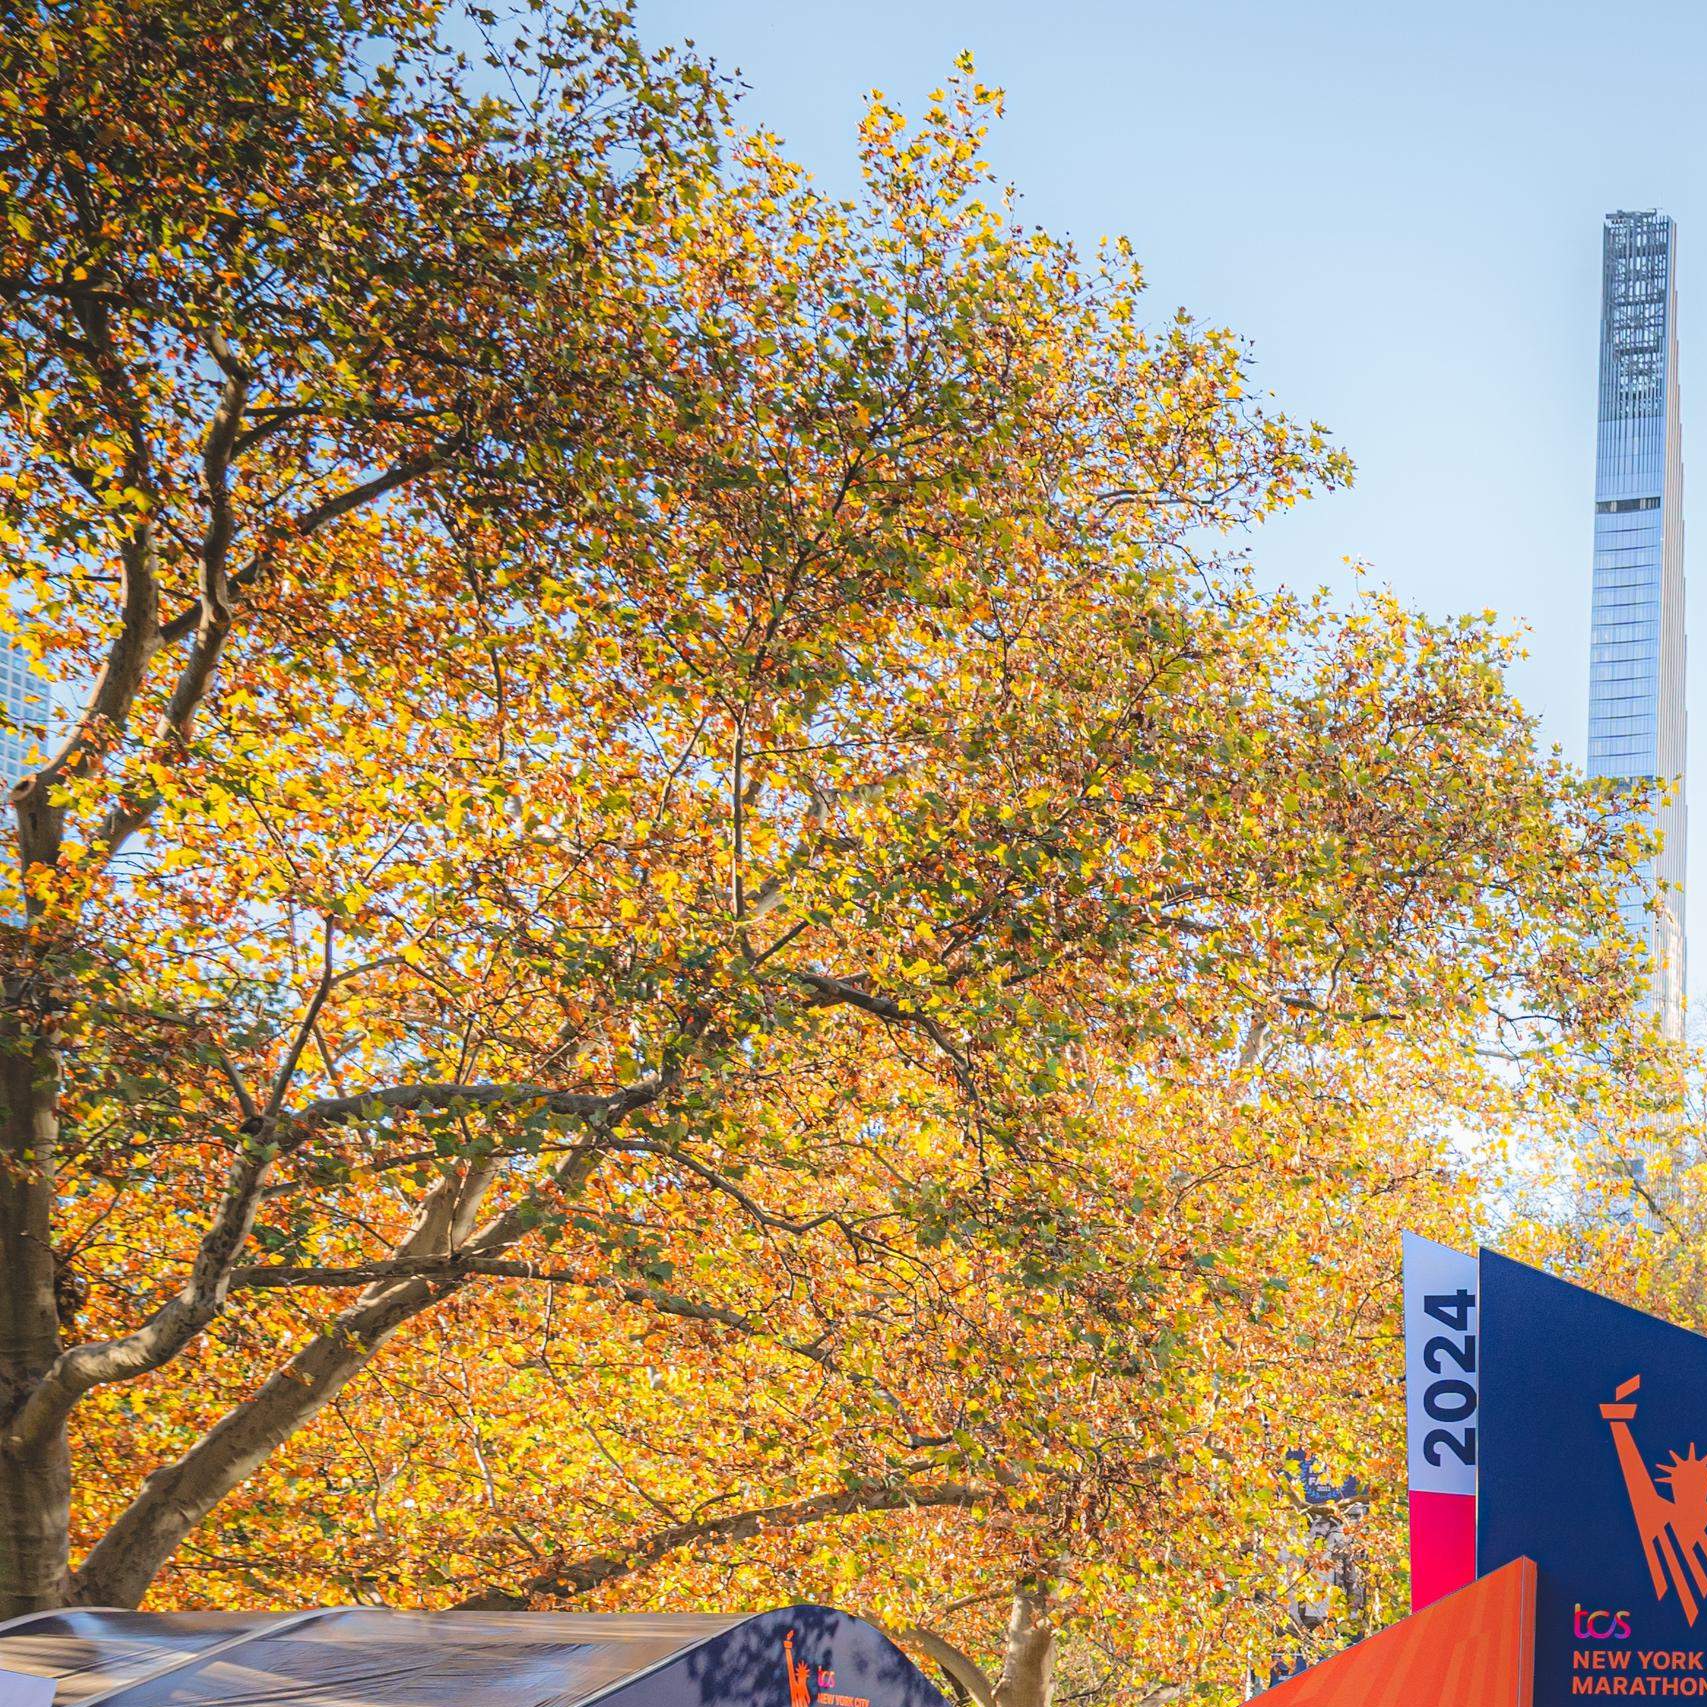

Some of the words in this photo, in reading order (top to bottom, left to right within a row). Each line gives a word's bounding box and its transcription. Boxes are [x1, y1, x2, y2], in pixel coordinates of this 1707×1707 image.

[1424, 1289, 1477, 1467] 2024
[1573, 1603, 1632, 1640] tcs
[1572, 1650, 1631, 1670] NEW
[1638, 1651, 1704, 1671] YORK
[817, 1666, 836, 1689] tcs
[817, 1693, 834, 1705] NEW
[835, 1695, 854, 1707] YORK
